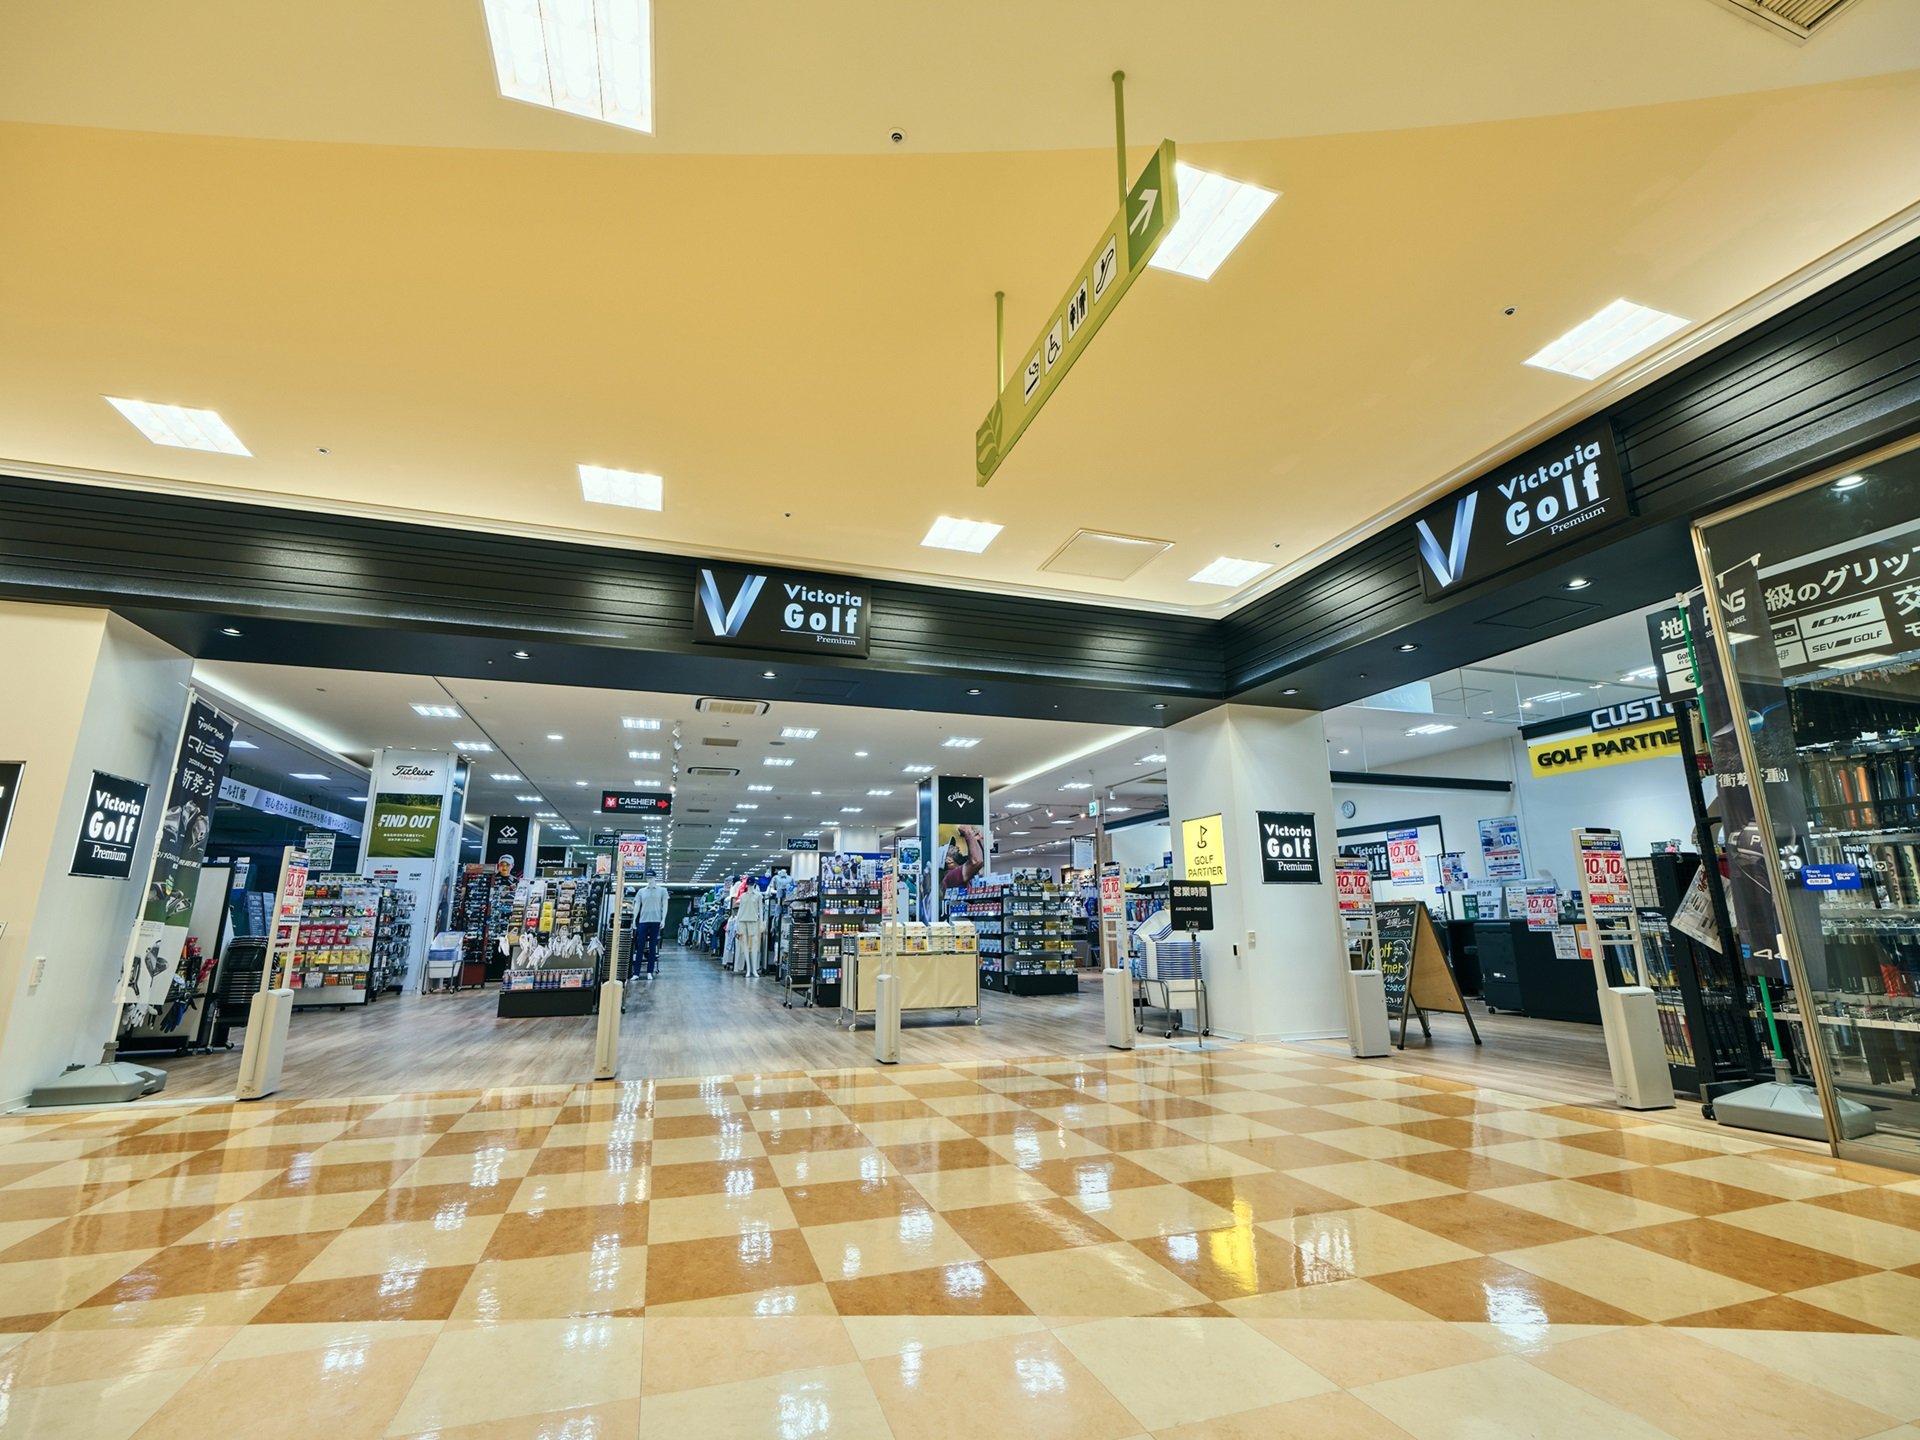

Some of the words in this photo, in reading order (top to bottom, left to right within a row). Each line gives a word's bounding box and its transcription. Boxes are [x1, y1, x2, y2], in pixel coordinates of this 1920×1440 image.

[1498, 441, 1601, 500] Victoria
[1505, 462, 1600, 535] Golf
[1550, 506, 1606, 535] Premium
[783, 583, 862, 607] Victoria
[1702, 588, 1746, 627] PNG
[784, 603, 857, 634] Golf
[796, 635, 856, 646] Premium
[1812, 641, 1834, 653] SEV
[1853, 630, 1882, 643] GOLF
[1537, 745, 1588, 767] GOLF
[1591, 727, 1680, 758] PARTNE
[392, 764, 436, 777] Titleist
[96, 789, 141, 816] Victoria
[618, 797, 656, 806] CASHIER
[947, 792, 975, 803] Callaway
[88, 811, 136, 844] Golf
[378, 814, 408, 828] FIND
[408, 815, 436, 829] OUT
[1263, 823, 1312, 837] Victoria
[91, 844, 127, 862] Premium
[1267, 837, 1311, 858] Golf
[1351, 845, 1386, 856] Victoria
[1194, 855, 1214, 865] GOLF
[1278, 861, 1312, 871] Premium
[1188, 866, 1223, 877] PARTNER
[1173, 887, 1207, 897] 営業時間
